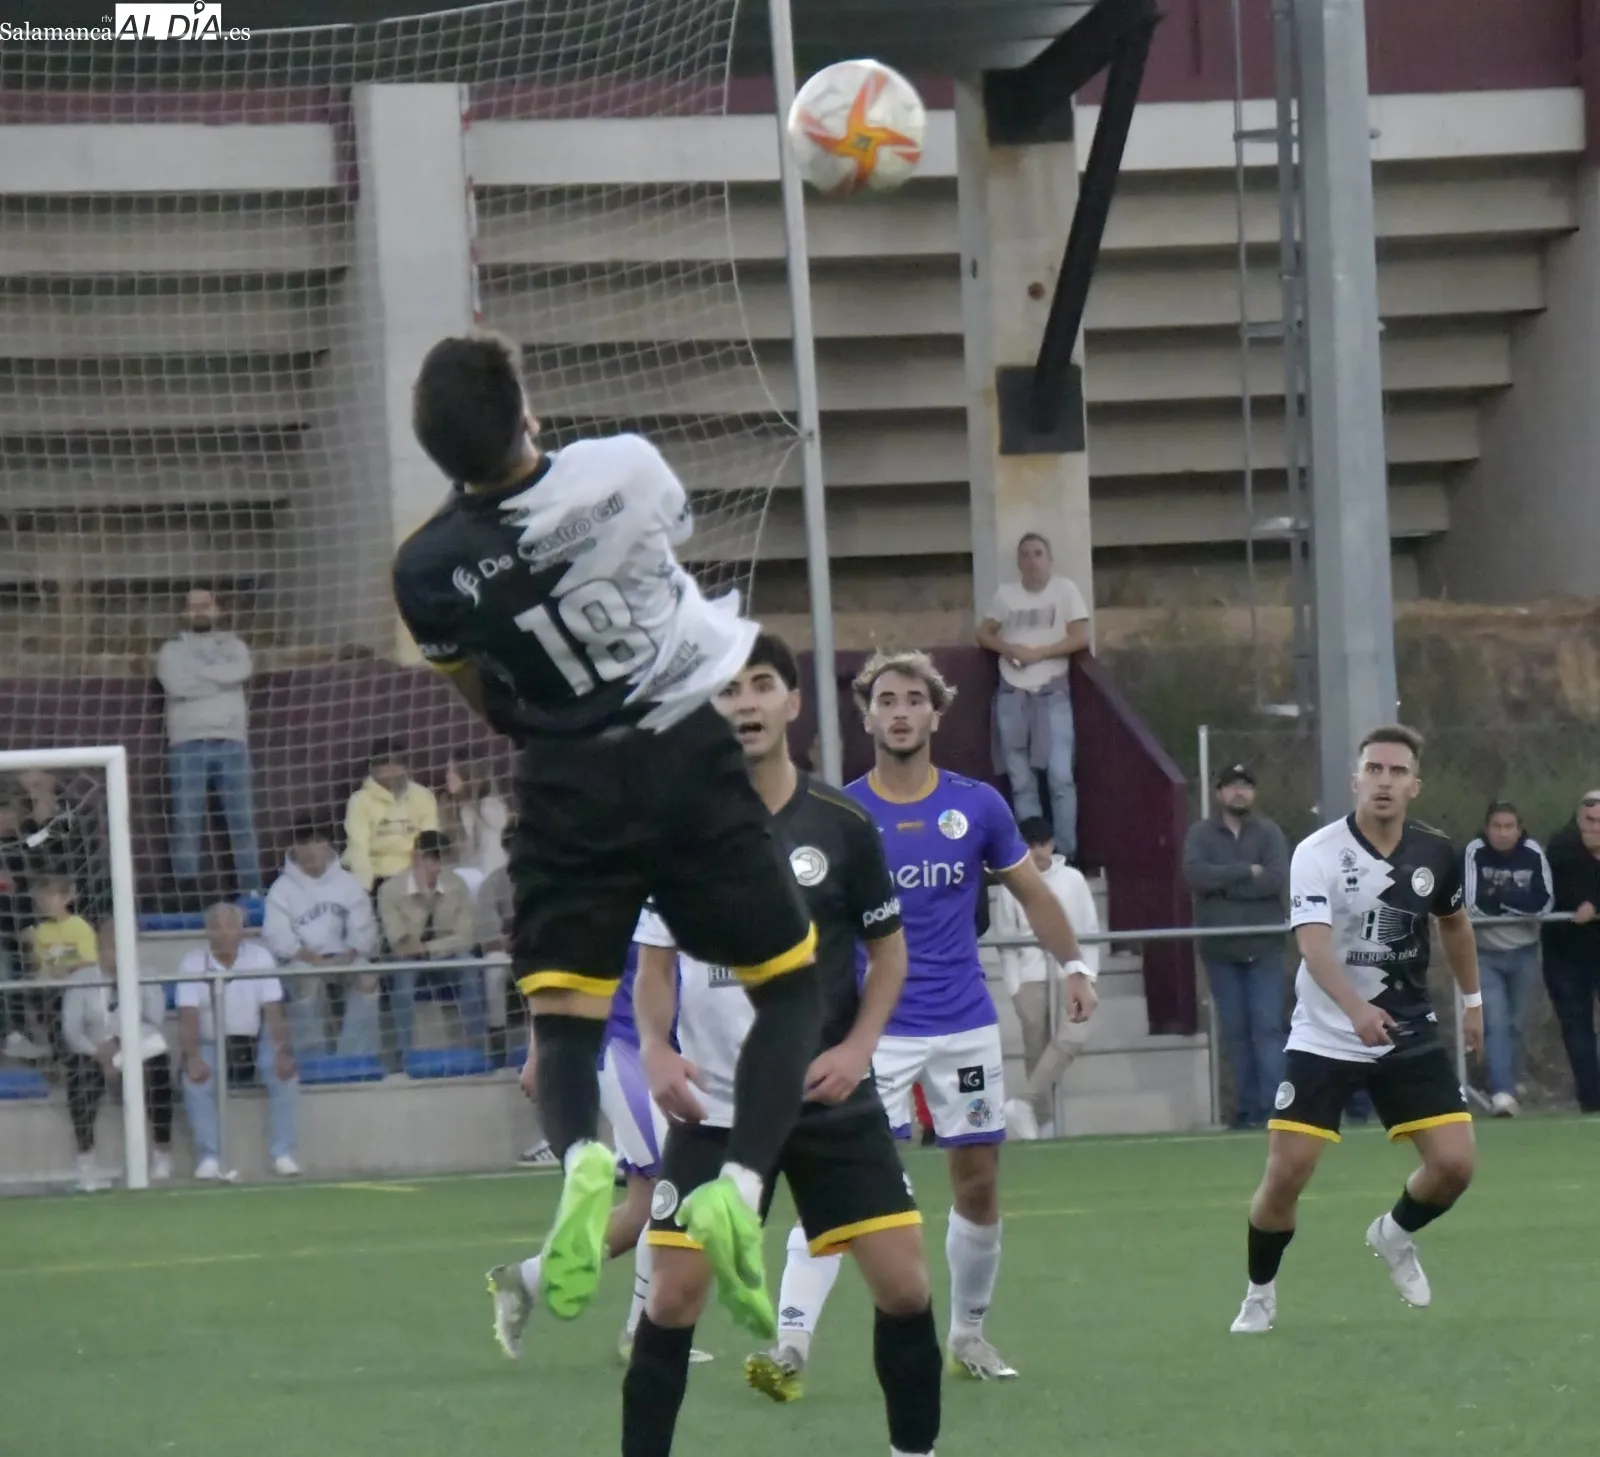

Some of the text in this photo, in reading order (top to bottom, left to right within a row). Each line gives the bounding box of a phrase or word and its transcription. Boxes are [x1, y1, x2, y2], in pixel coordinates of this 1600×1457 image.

[478, 554, 514, 579] De
[592, 491, 624, 524] Gil
[513, 578, 659, 697] 18
[889, 860, 965, 889] eins
